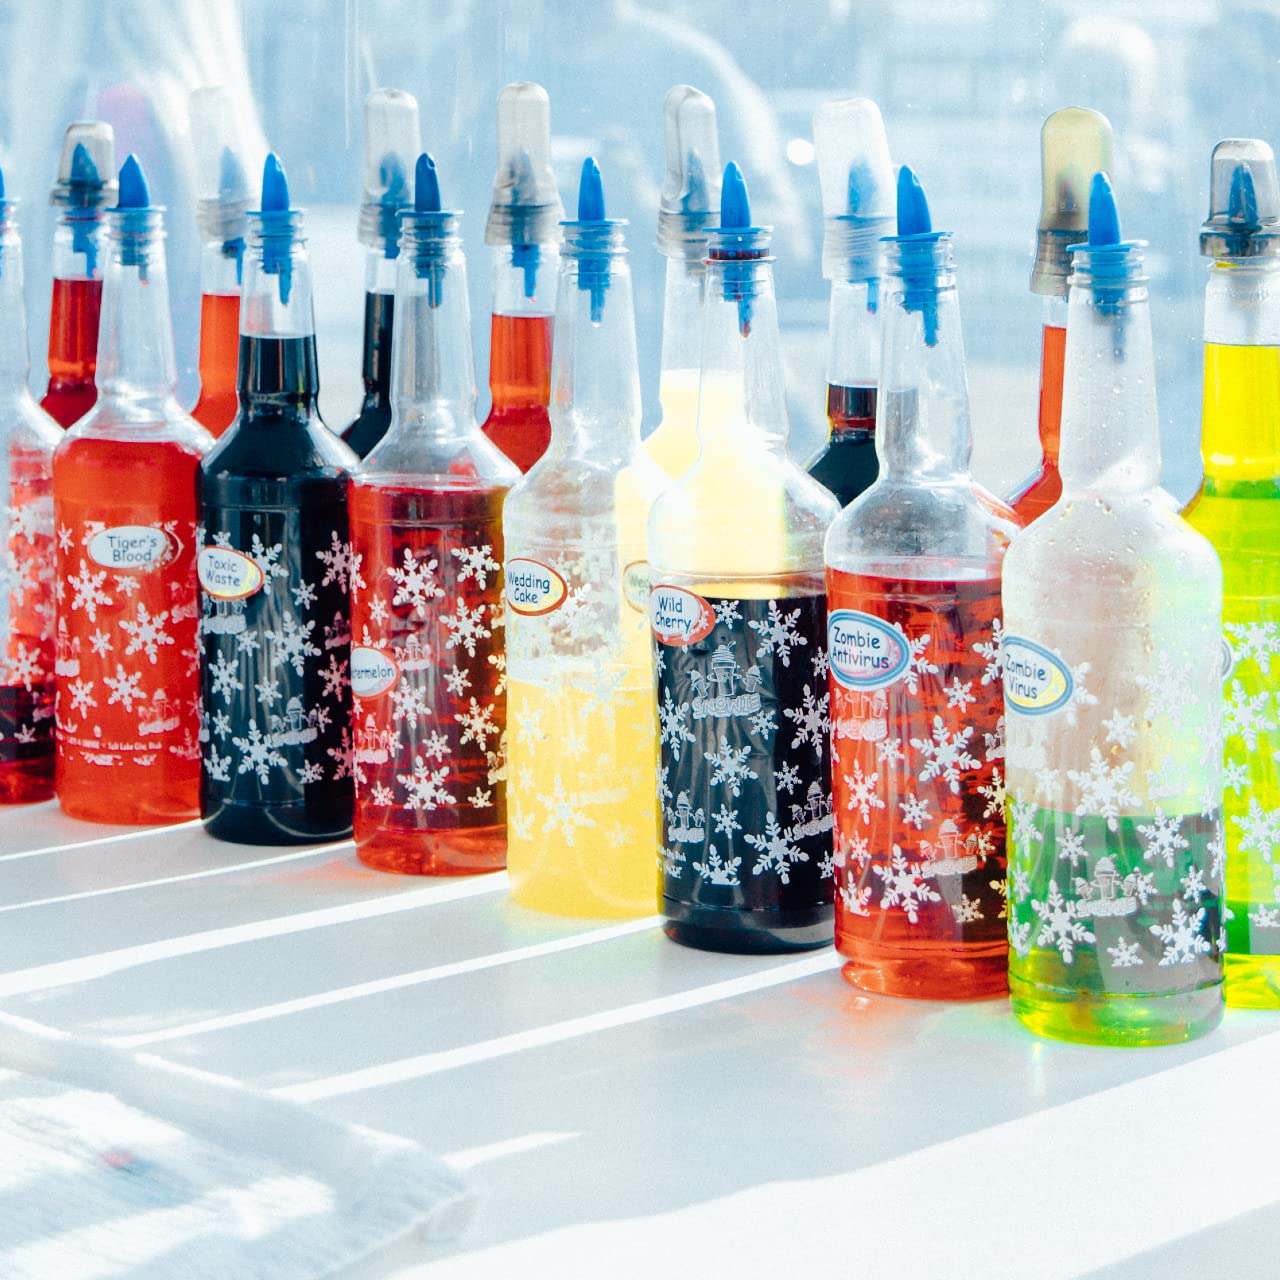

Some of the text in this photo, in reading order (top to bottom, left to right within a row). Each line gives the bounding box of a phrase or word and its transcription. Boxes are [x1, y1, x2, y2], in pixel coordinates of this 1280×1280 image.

[107, 535, 157, 552] Tiger's
[113, 549, 152, 562] Blood
[208, 555, 237, 573] Toxic
[206, 571, 241, 587] Waste
[507, 571, 550, 594] Wedding
[514, 588, 538, 604] Cake
[658, 595, 683, 613] Wild
[655, 611, 691, 631] Cherry
[833, 625, 881, 649] Zombie
[832, 646, 889, 670] Antivirus
[1005, 653, 1046, 681] Zombie
[1009, 678, 1038, 699] Virus
[692, 693, 762, 719] SNOWIE
